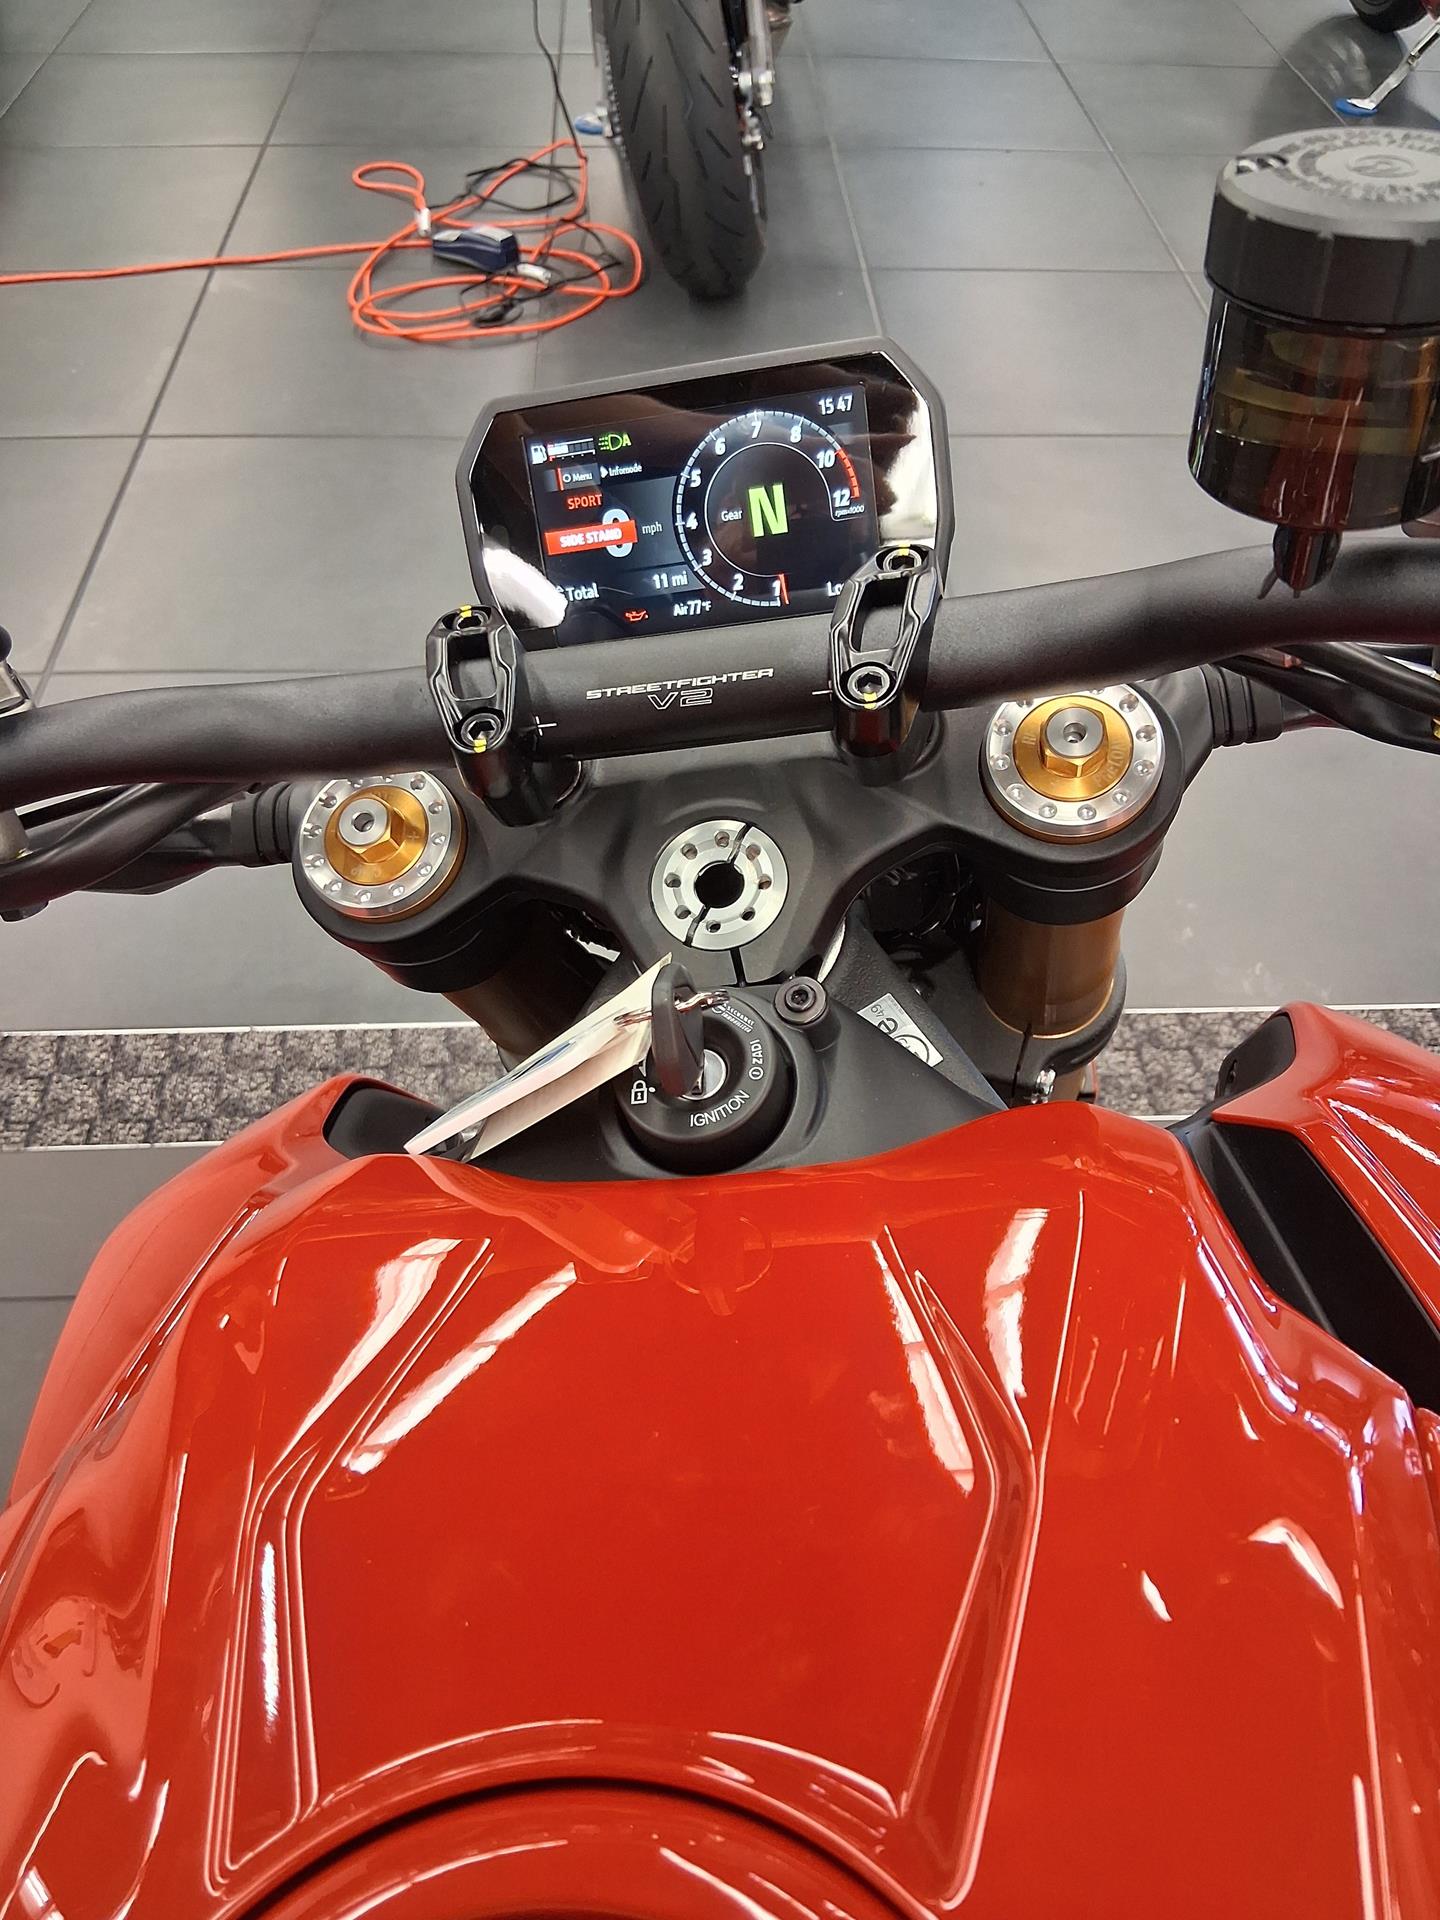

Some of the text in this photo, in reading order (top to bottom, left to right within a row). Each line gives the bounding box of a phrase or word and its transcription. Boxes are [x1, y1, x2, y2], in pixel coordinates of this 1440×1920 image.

[751, 421, 762, 439] 7
[790, 425, 802, 443] 8
[622, 433, 632, 447] A
[714, 437, 726, 455] 6
[816, 451, 836, 469] 10
[572, 471, 593, 483] Menu
[689, 468, 702, 488] 5
[567, 493, 602, 510] SPORT
[832, 489, 851, 507] 12
[721, 509, 742, 522] Gear
[748, 483, 789, 538] N
[642, 523, 663, 536] mph
[685, 511, 698, 530] 4
[559, 528, 623, 548] SIDE STAND
[701, 549, 713, 566] 3
[652, 571, 688, 589] 11 mi
[732, 573, 744, 591] 2
[772, 580, 781, 597] 1
[827, 580, 849, 597] Lo
[565, 582, 600, 602] Total
[585, 667, 774, 700] STREETFIGHTER
[647, 687, 714, 710] V2
[750, 1039, 763, 1065] ZADI
[689, 1089, 750, 1128] IGNITION
